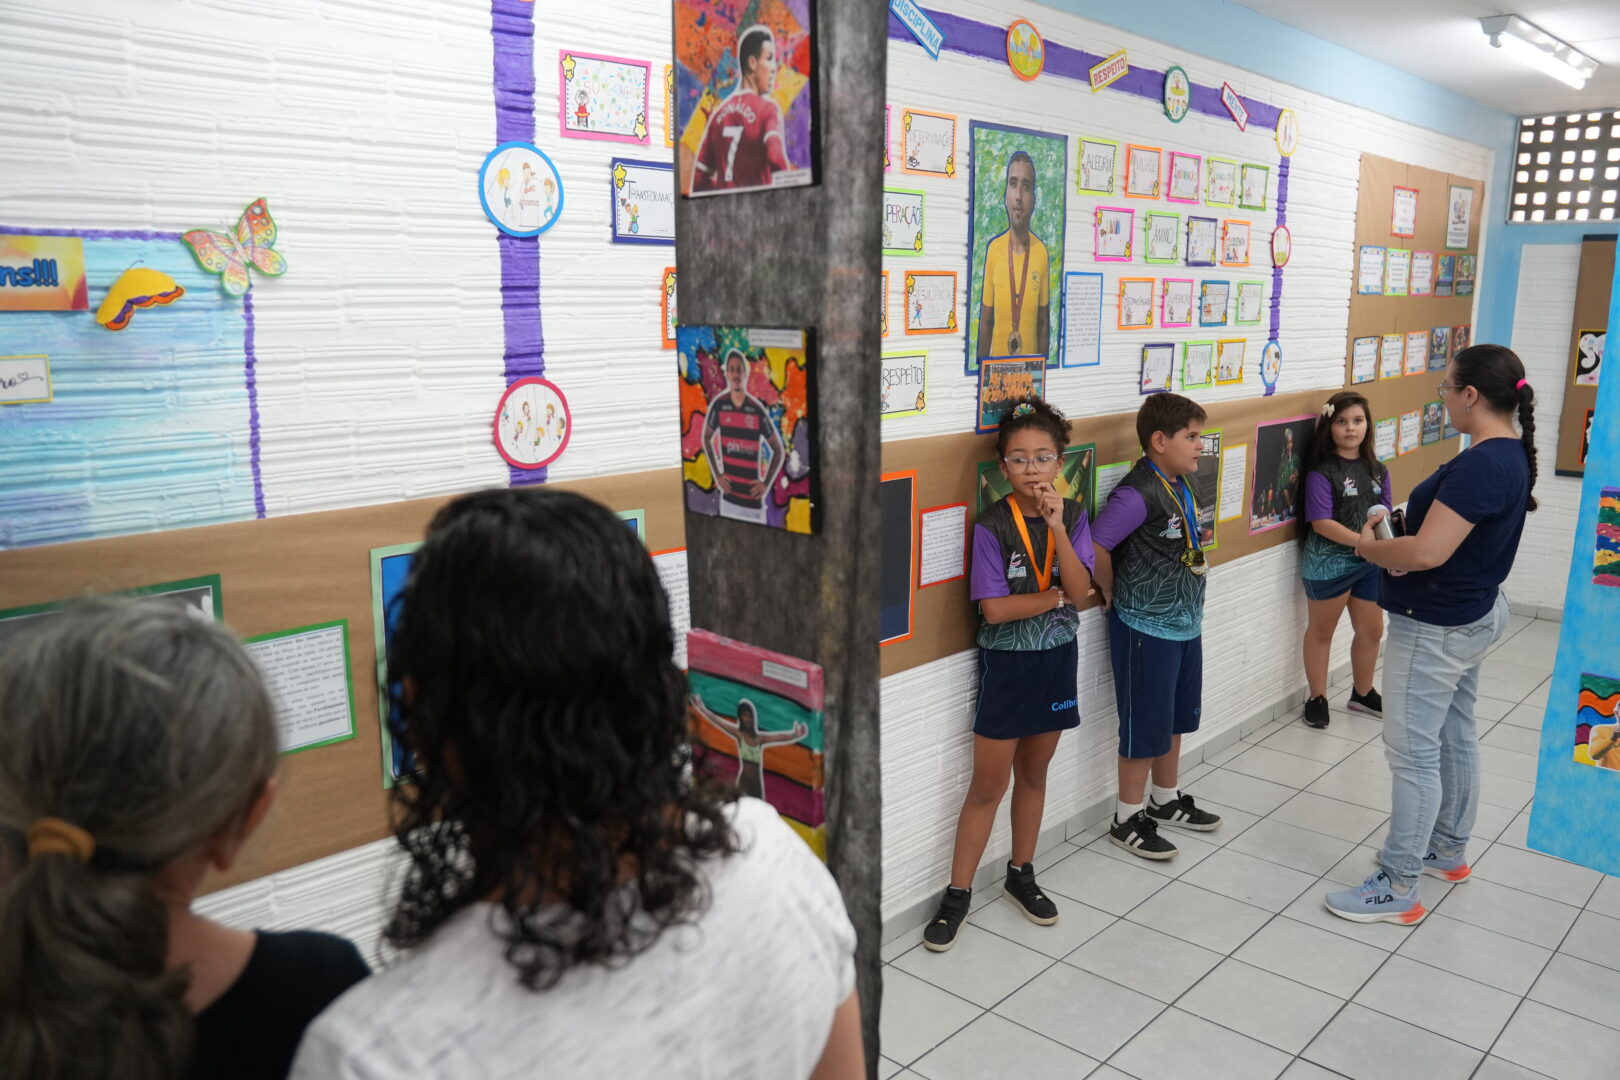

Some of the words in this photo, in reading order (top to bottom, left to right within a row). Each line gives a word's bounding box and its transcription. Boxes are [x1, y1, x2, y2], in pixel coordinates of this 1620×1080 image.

[1093, 57, 1125, 86] RESPEITO
[1226, 91, 1244, 123] MENTE
[722, 126, 743, 182] 7
[1365, 894, 1394, 905] FILA
